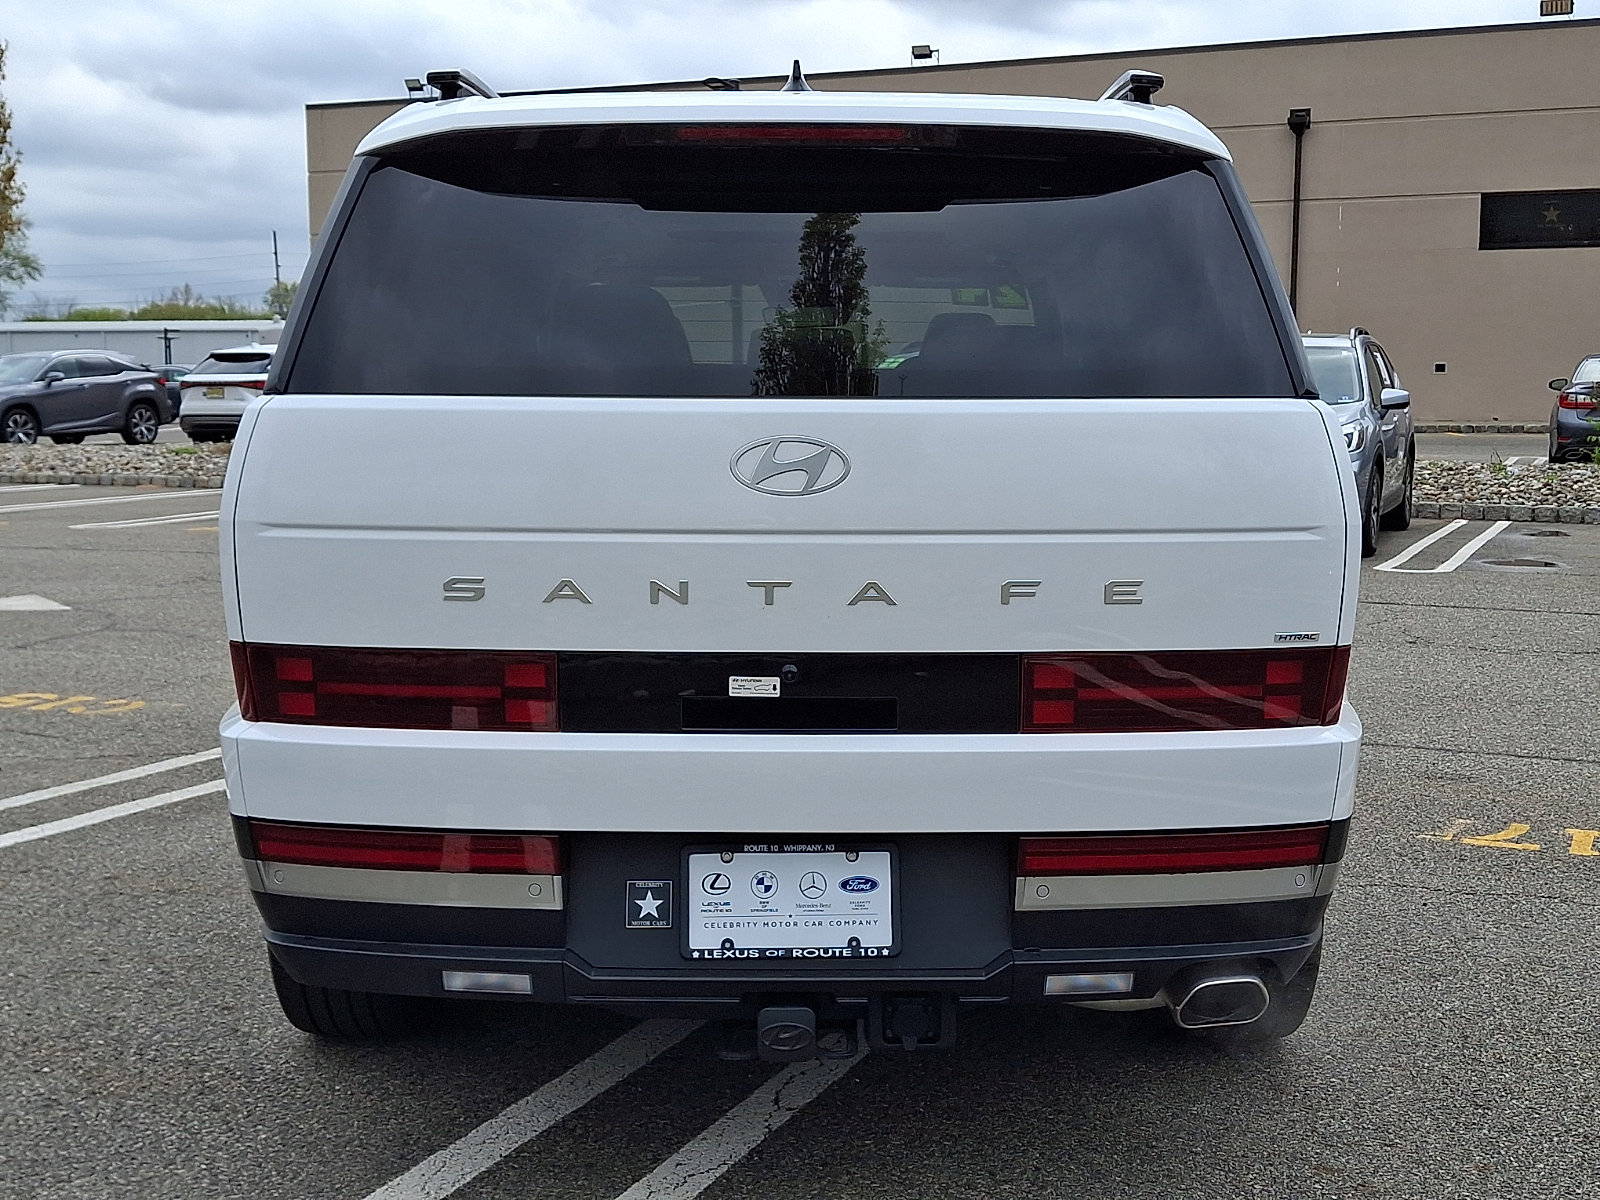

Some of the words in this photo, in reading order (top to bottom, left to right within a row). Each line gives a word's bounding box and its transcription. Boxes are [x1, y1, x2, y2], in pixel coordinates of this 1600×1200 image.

[443, 576, 898, 605] SANTA
[1001, 579, 1144, 605] FE
[1278, 633, 1318, 641] HTRAC
[743, 844, 769, 852] ROUTE
[770, 844, 779, 852] 10
[846, 879, 872, 890] Ford
[703, 921, 758, 929] CELEBRITY
[763, 920, 799, 928] MOTOR
[829, 919, 879, 927] COMPANY
[704, 949, 760, 959] LEXUS
[766, 949, 786, 957] OF
[792, 948, 852, 958] ROUTE
[859, 948, 878, 957] 10
